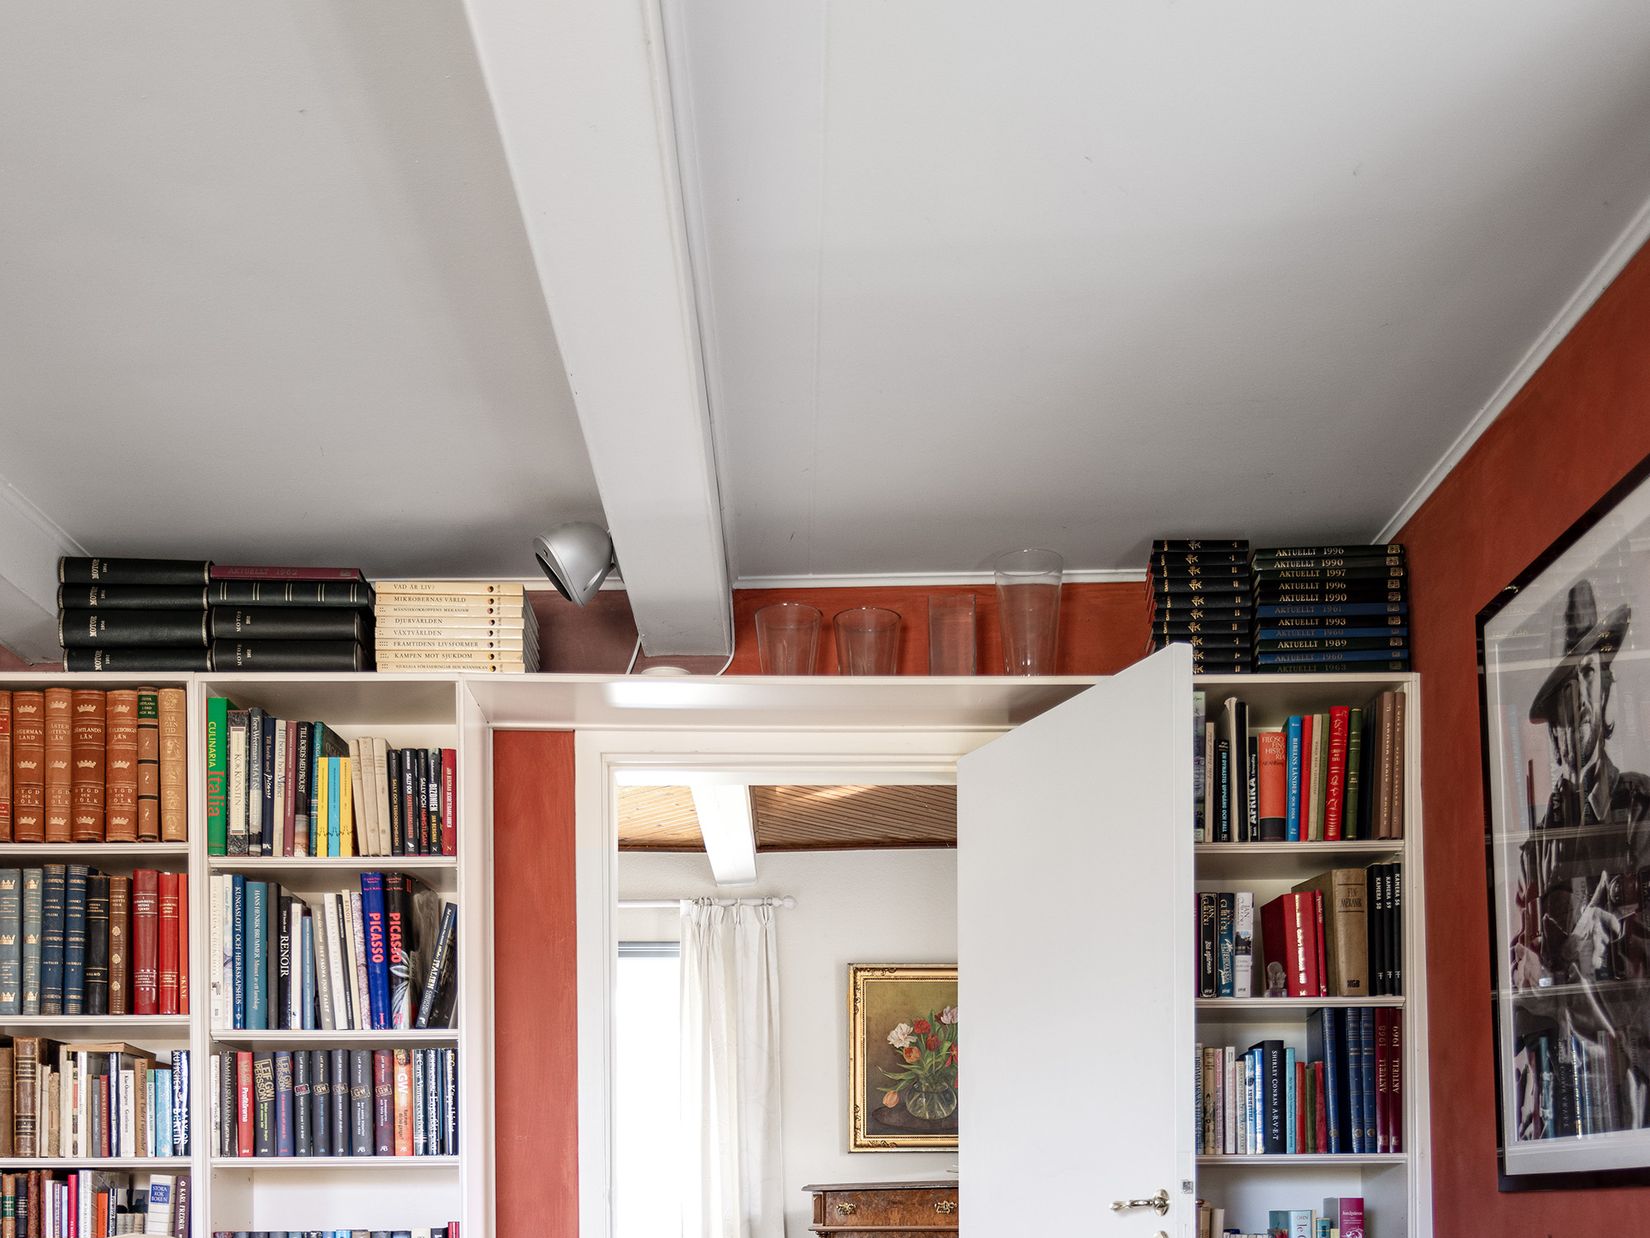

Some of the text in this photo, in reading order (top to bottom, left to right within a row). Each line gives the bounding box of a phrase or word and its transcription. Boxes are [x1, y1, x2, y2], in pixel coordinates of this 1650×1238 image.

[1275, 547, 1344, 557] AKTUELLT 1996
[1274, 560, 1315, 568] AKTUELLT
[1279, 569, 1346, 578] AKTUELLT 1997
[1279, 581, 1319, 590] AKTUELLT
[1279, 594, 1319, 602] AKTUELLT
[1274, 606, 1315, 614] AKTUELLT
[89, 616, 98, 637] MOTOR
[395, 617, 443, 625] DJURVÄRLDEN
[1278, 618, 1319, 626] AKTUELLT
[1276, 628, 1315, 636] AKTUELLT
[1278, 639, 1347, 649] AKTUELLT 1989
[94, 650, 103, 671] MOTOR
[1275, 653, 1315, 662] AKTUELLT
[1276, 665, 1317, 673] AKTUELLT
[299, 740, 307, 759] BORDS
[208, 722, 225, 817] CULINARIA Italia
[298, 771, 306, 793] PROUST
[1291, 767, 1299, 795] LÄNDER
[429, 783, 438, 811] BIZONIEN
[1249, 778, 1257, 824] AFRIKA
[1207, 905, 1215, 919] JAN
[369, 912, 384, 963] PICASSO
[389, 912, 402, 963] PICASSO
[280, 935, 289, 977] RENOIR
[428, 959, 441, 990] ITALIEN
[1392, 1025, 1400, 1047] 1969
[254, 1063, 266, 1100] PERSSON
[260, 1062, 275, 1098] LEIF GW
[397, 1072, 409, 1094] GW
[178, 1208, 186, 1230] FREDRIK
[1297, 1224, 1308, 1233] le
